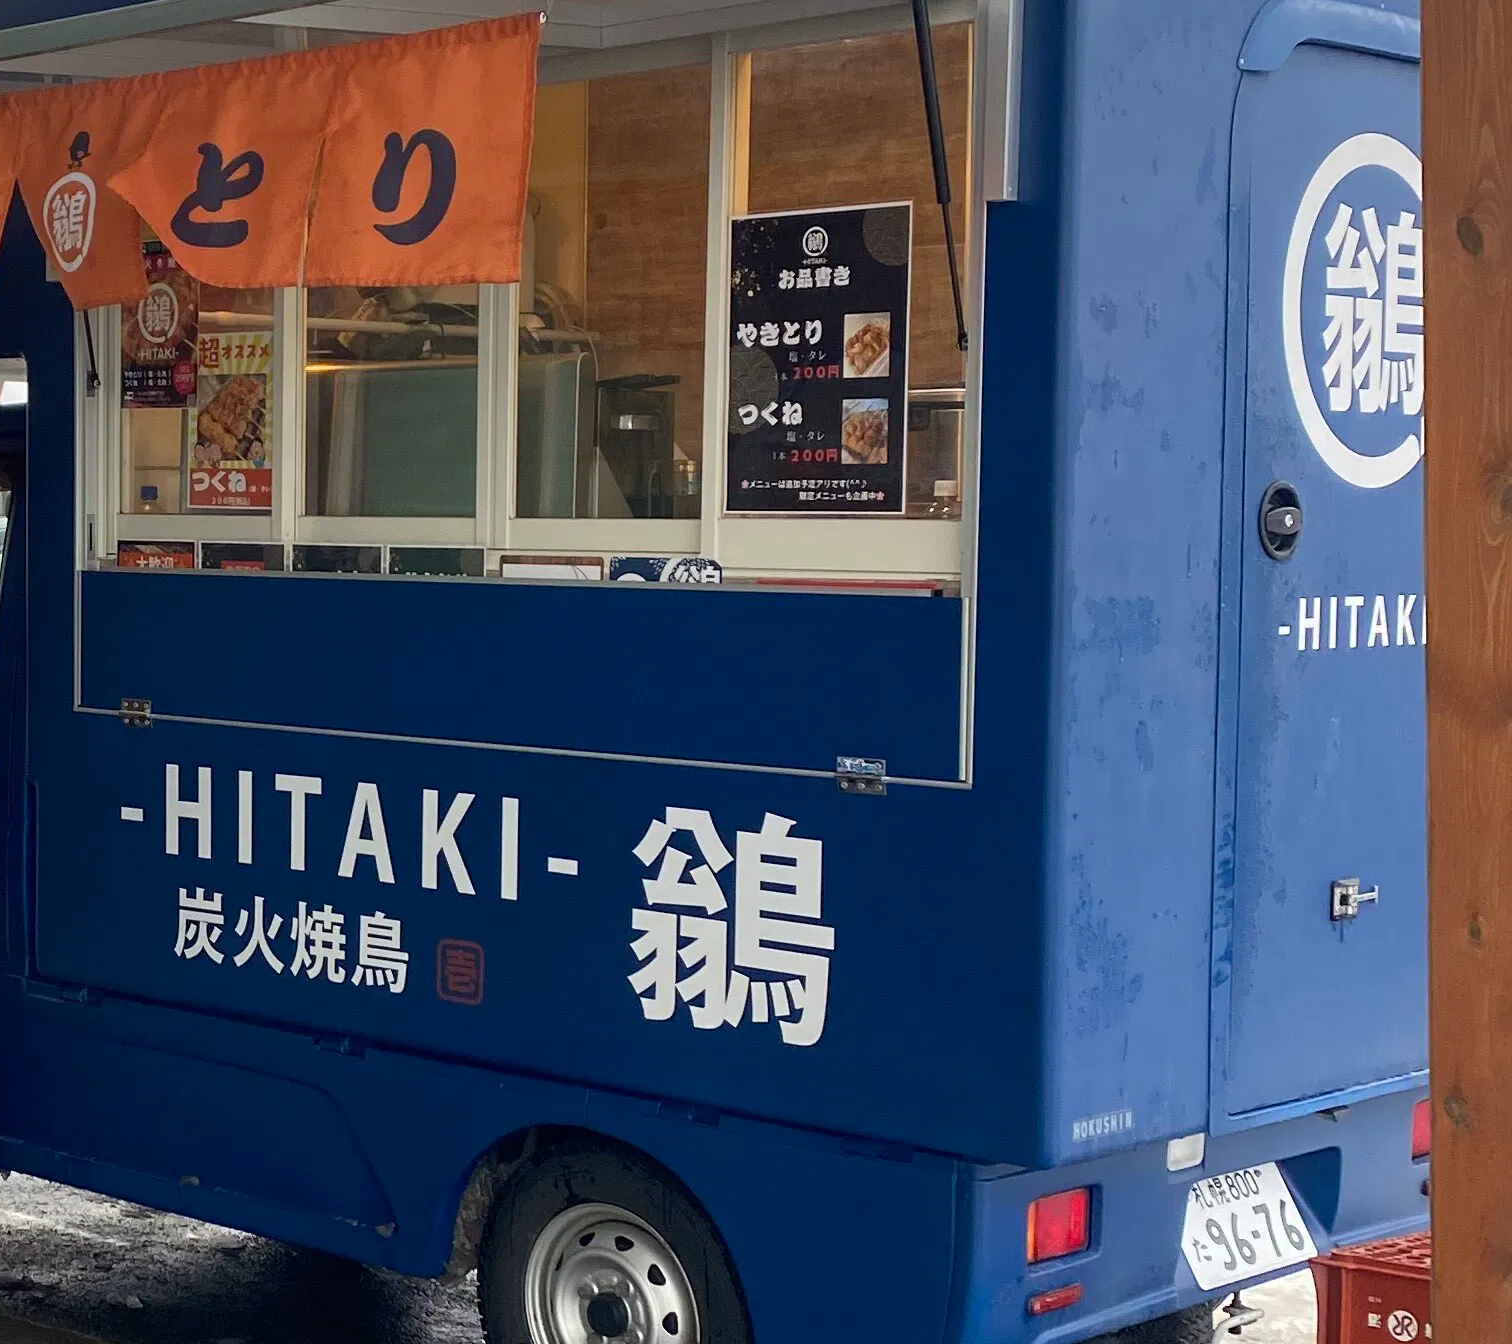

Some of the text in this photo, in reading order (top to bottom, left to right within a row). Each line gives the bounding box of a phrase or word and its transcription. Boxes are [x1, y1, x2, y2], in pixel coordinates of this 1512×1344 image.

[778, 265, 851, 290] お品書き
[736, 319, 823, 348] やきとり
[199, 337, 270, 369] 超オススメ
[793, 364, 840, 380] 200円
[737, 400, 803, 426] つくね
[790, 448, 838, 463] 200円
[191, 470, 247, 493] つくね
[627, 806, 836, 1047] 鶲
[174, 887, 410, 995] 炭火焼鳥
[1073, 1111, 1133, 1140] HOKUSHIN
[1225, 1169, 1260, 1201] 800
[1192, 1236, 1213, 1263] た
